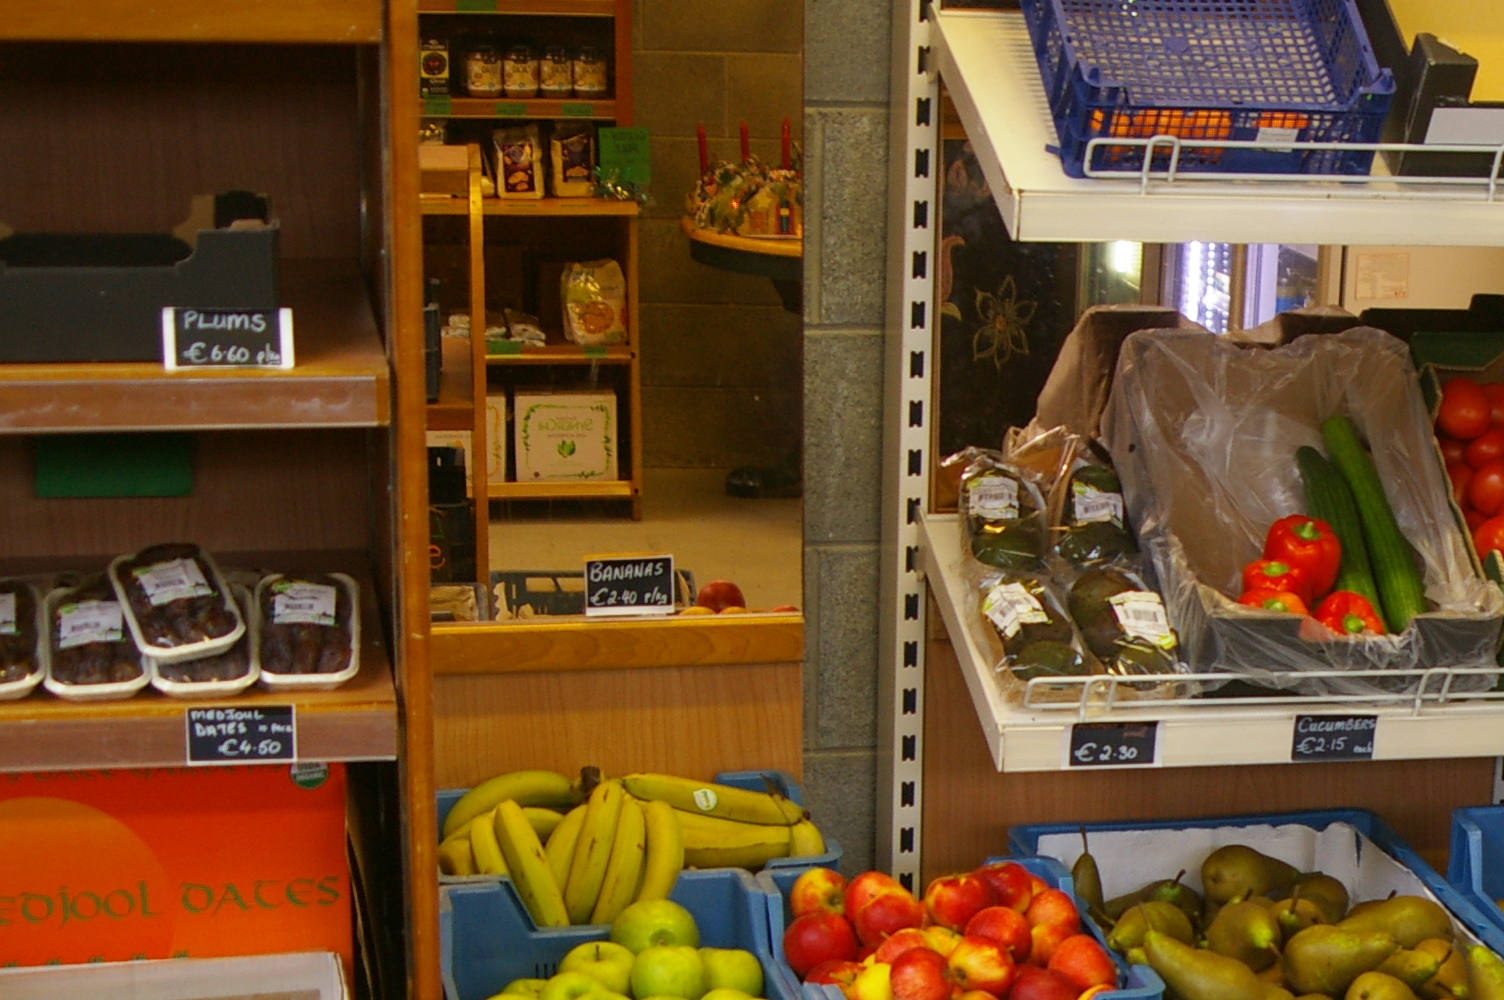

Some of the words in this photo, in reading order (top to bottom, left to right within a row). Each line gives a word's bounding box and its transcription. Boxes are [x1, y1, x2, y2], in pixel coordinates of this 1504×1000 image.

[183, 310, 267, 333] PLUMS
[589, 562, 664, 582] BANANAS
[194, 722, 247, 738] DATES
[181, 875, 342, 915] DATES
